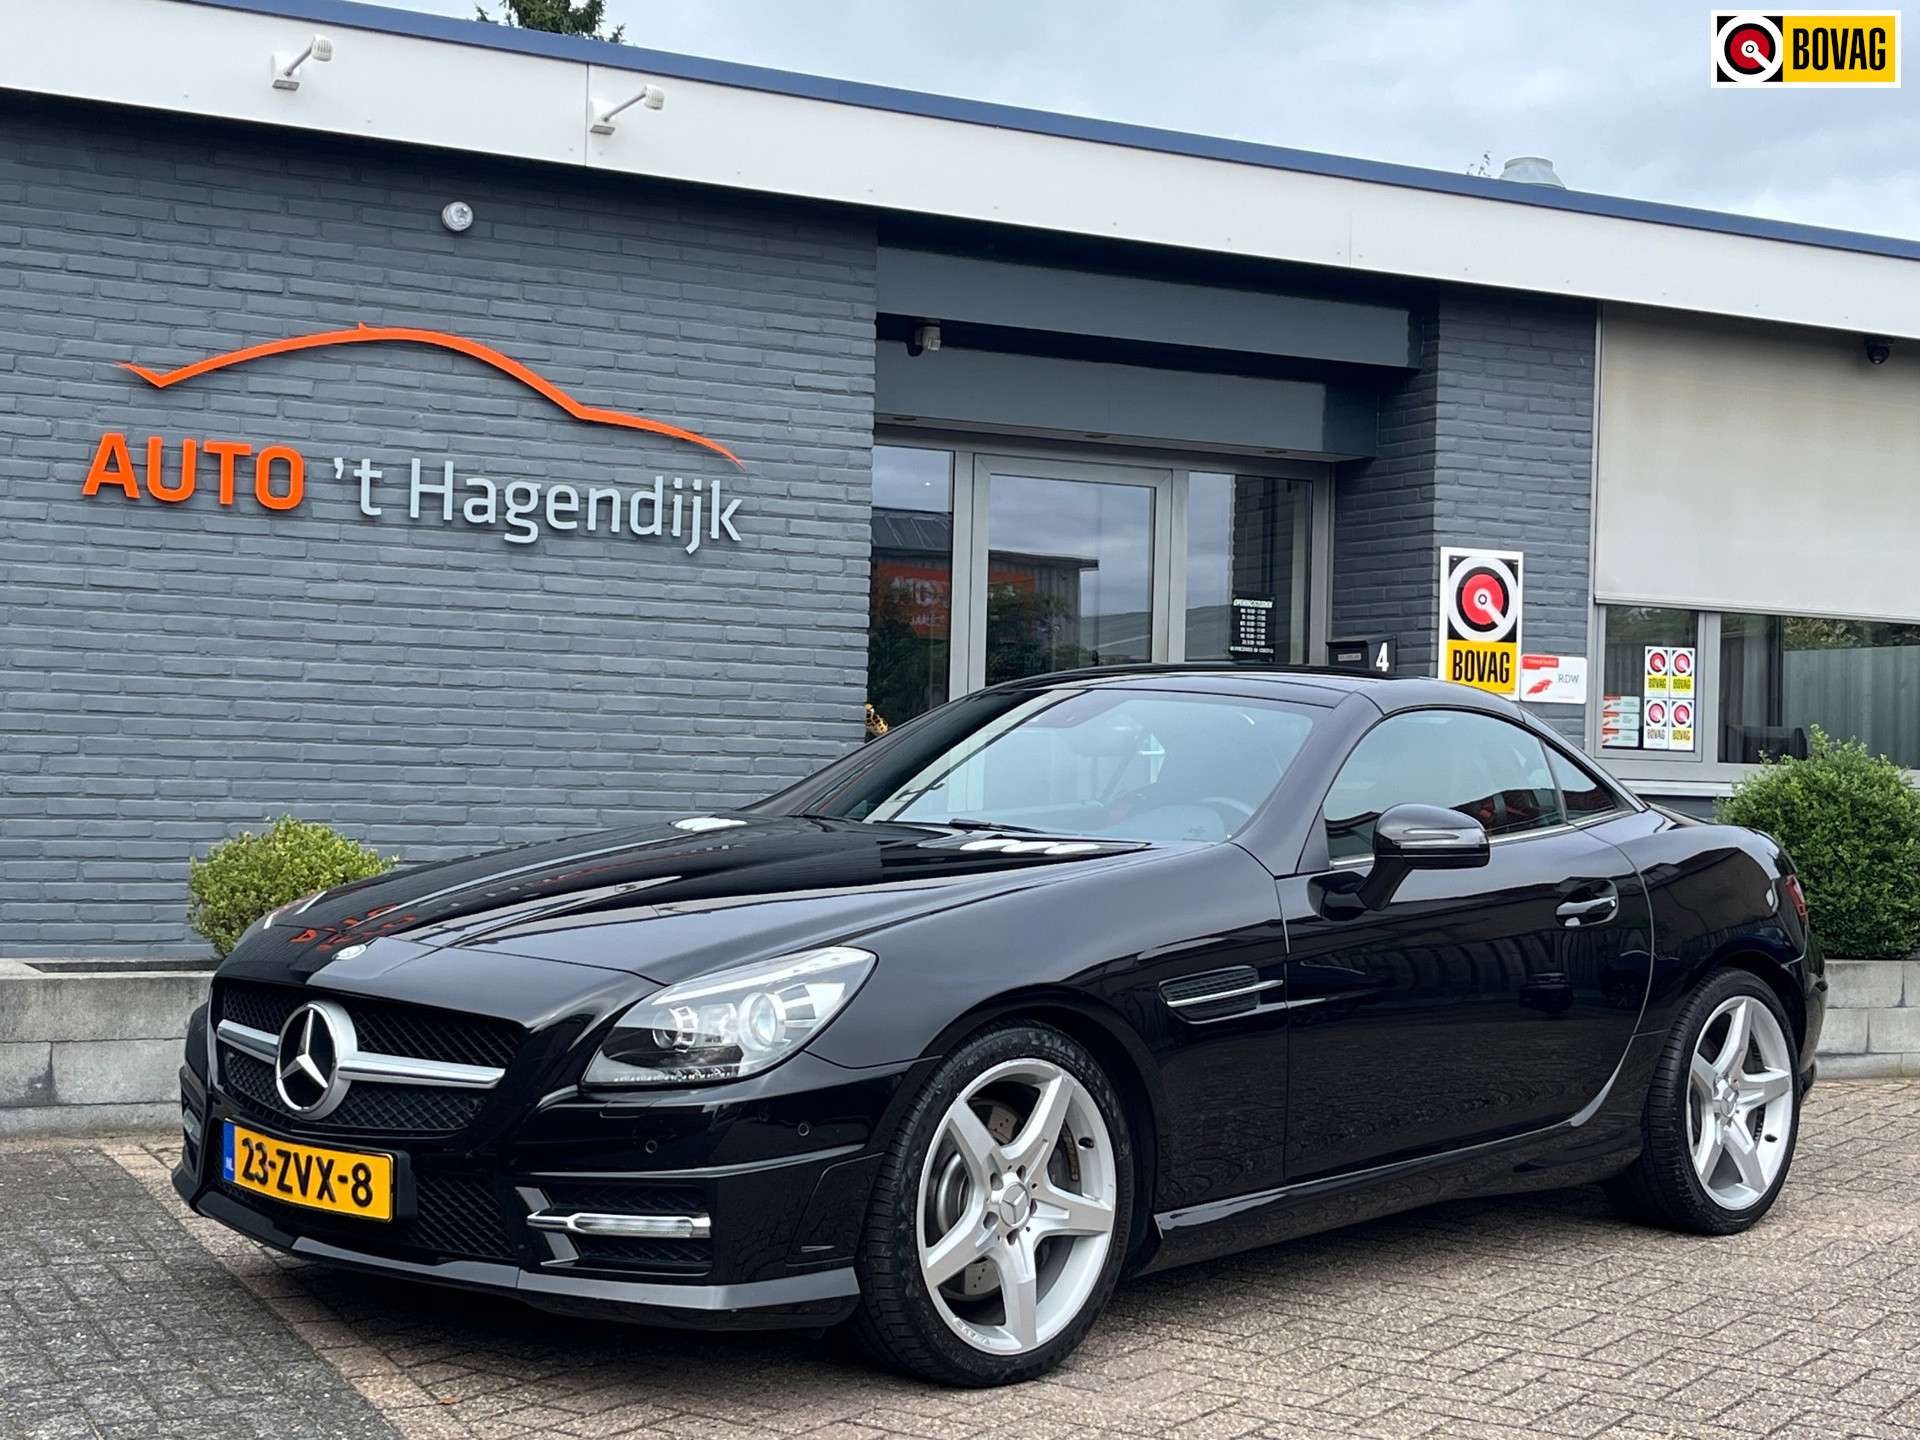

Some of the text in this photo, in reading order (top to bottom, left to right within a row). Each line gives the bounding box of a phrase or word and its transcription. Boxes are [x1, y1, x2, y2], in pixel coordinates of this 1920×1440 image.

[81, 431, 305, 511] AUTO
[409, 457, 743, 554] Hagendijk
[1375, 642, 1390, 672] 4
[1452, 649, 1510, 684] BOVAG
[1558, 673, 1580, 684] RDW
[241, 1137, 373, 1208] 23-ZVX-8
